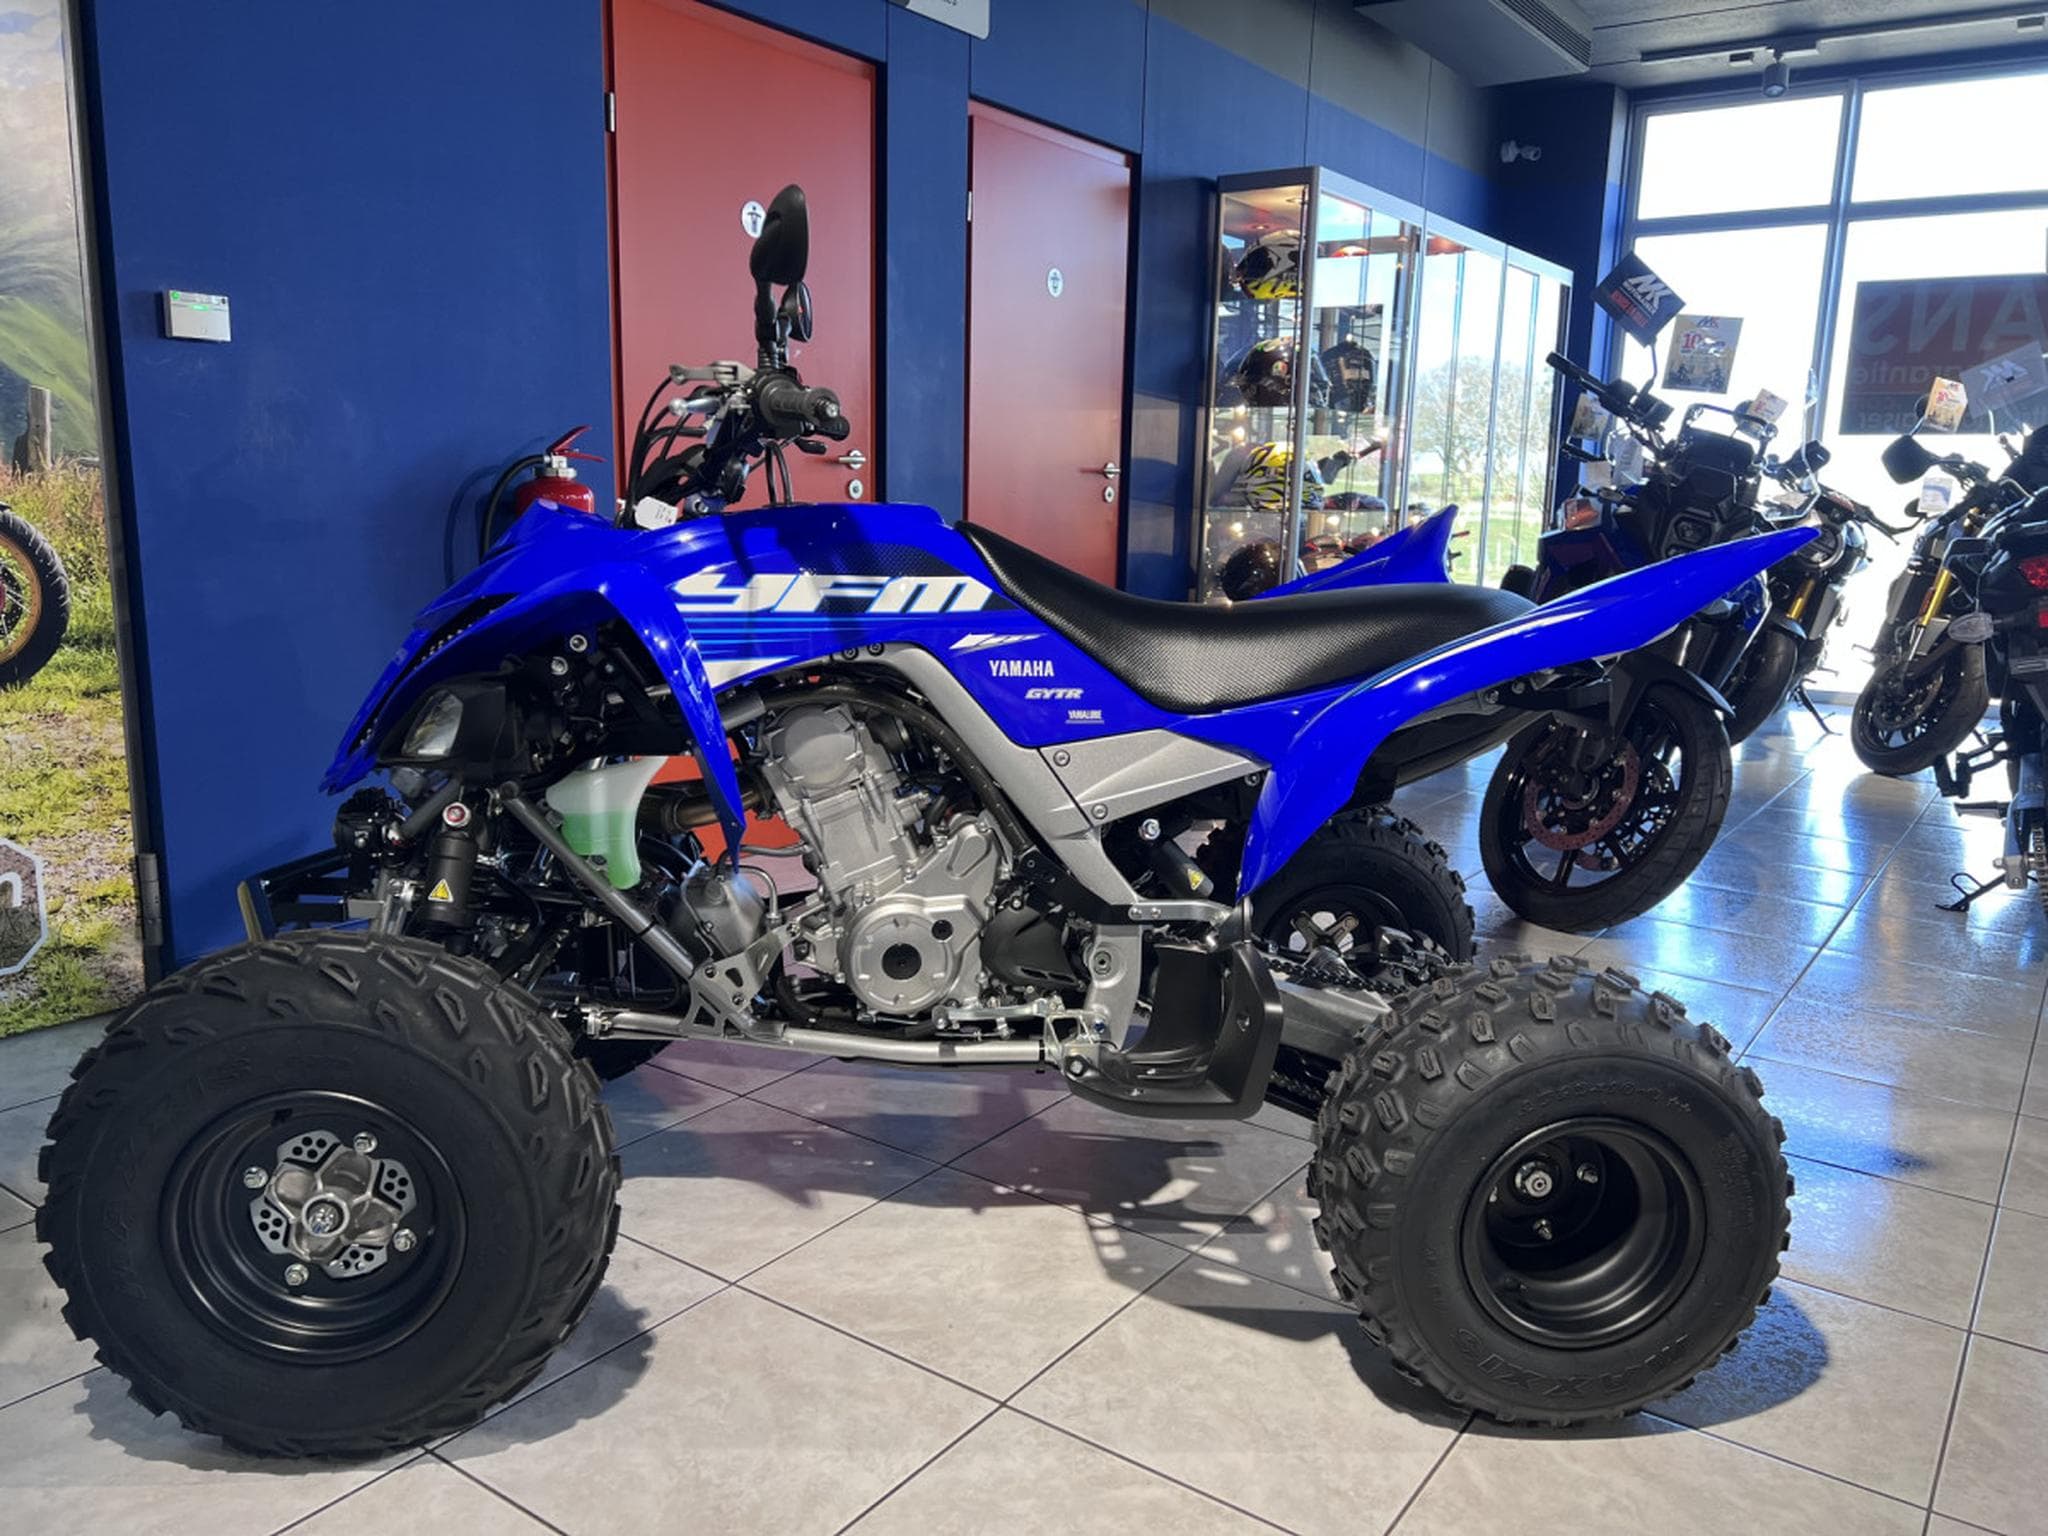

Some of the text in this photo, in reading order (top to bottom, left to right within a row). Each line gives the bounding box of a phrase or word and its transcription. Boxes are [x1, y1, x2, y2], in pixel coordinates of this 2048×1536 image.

[673, 572, 994, 613] YFM
[988, 659, 1055, 677] YAMAHA
[1024, 687, 1084, 700] GYTR
